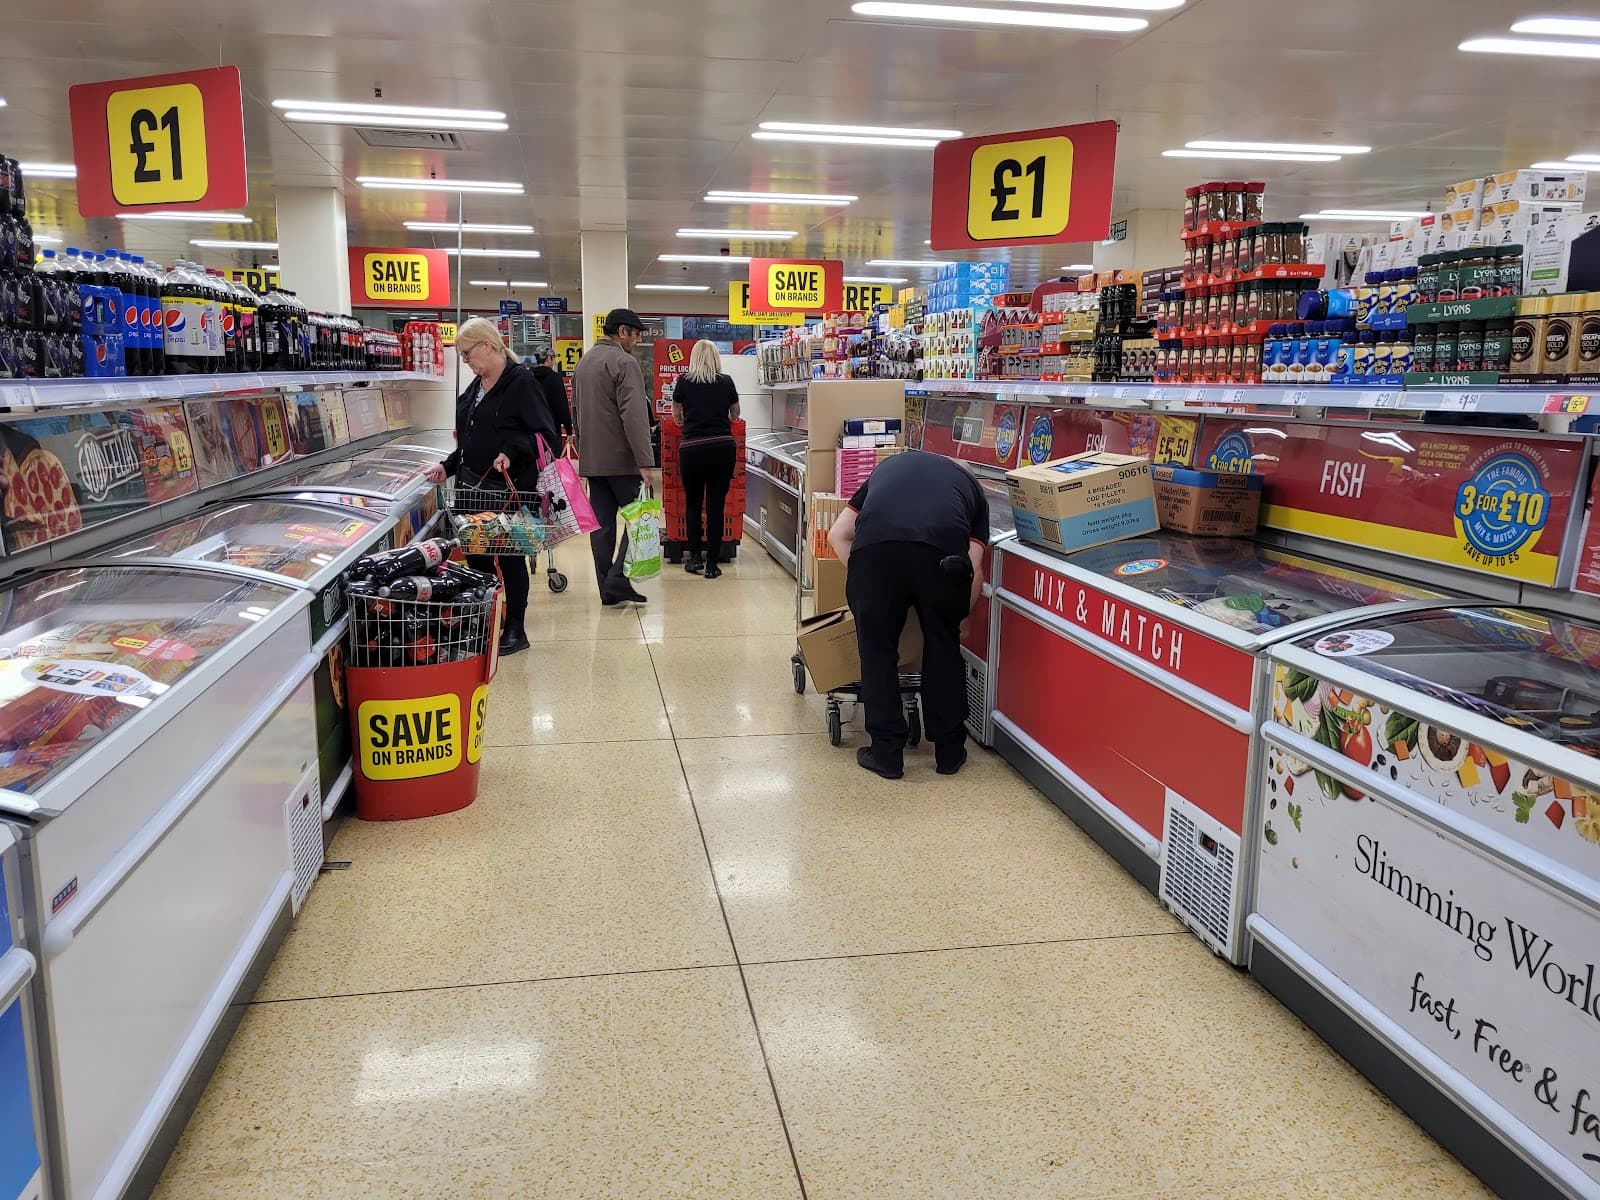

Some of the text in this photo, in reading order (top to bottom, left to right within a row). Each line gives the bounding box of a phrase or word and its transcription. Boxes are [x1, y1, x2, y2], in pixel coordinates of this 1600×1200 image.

[130, 106, 182, 183] £1
[990, 155, 1046, 221] £1
[372, 260, 421, 282] SAVE
[775, 270, 818, 291] SAVE
[373, 283, 422, 293] ON BRANDS
[775, 292, 818, 302] ON BRANDS
[846, 286, 882, 311] REE
[1443, 304, 1471, 317] LYONS
[440, 326, 454, 336] AVE
[1441, 375, 1470, 385] LYONS
[1374, 394, 1390, 407] £2
[1029, 432, 1035, 447] 3
[1040, 434, 1052, 450] £10
[1085, 433, 1107, 452] FISH
[1158, 436, 1189, 459] £5.50
[1210, 455, 1252, 473] 3 FOR £10
[1522, 444, 1541, 463] CHOOSE
[1539, 460, 1551, 479] FROM
[1118, 465, 1148, 480] 90616
[1218, 477, 1247, 487] Iceland
[1320, 459, 1366, 498] FISH
[1486, 466, 1528, 486] THE FAMOUS
[1086, 488, 1126, 503] COD FILLETS
[1092, 481, 1123, 494] BREADED
[1460, 485, 1544, 526] 3 FOR £10
[1081, 527, 1100, 536] Gross
[1100, 522, 1121, 534] weight
[1474, 521, 1518, 543] MIX & MATCH
[1463, 542, 1520, 567] SAVE UP TO £5
[1033, 569, 1183, 670] MIX & MATCH
[369, 707, 452, 748] SAVE
[372, 743, 453, 765] ON BRANDS
[1354, 834, 1497, 962] Slimming
[1409, 972, 1461, 1040] fast,
[1533, 1067, 1560, 1113] &
[1569, 1088, 1600, 1142] fa
